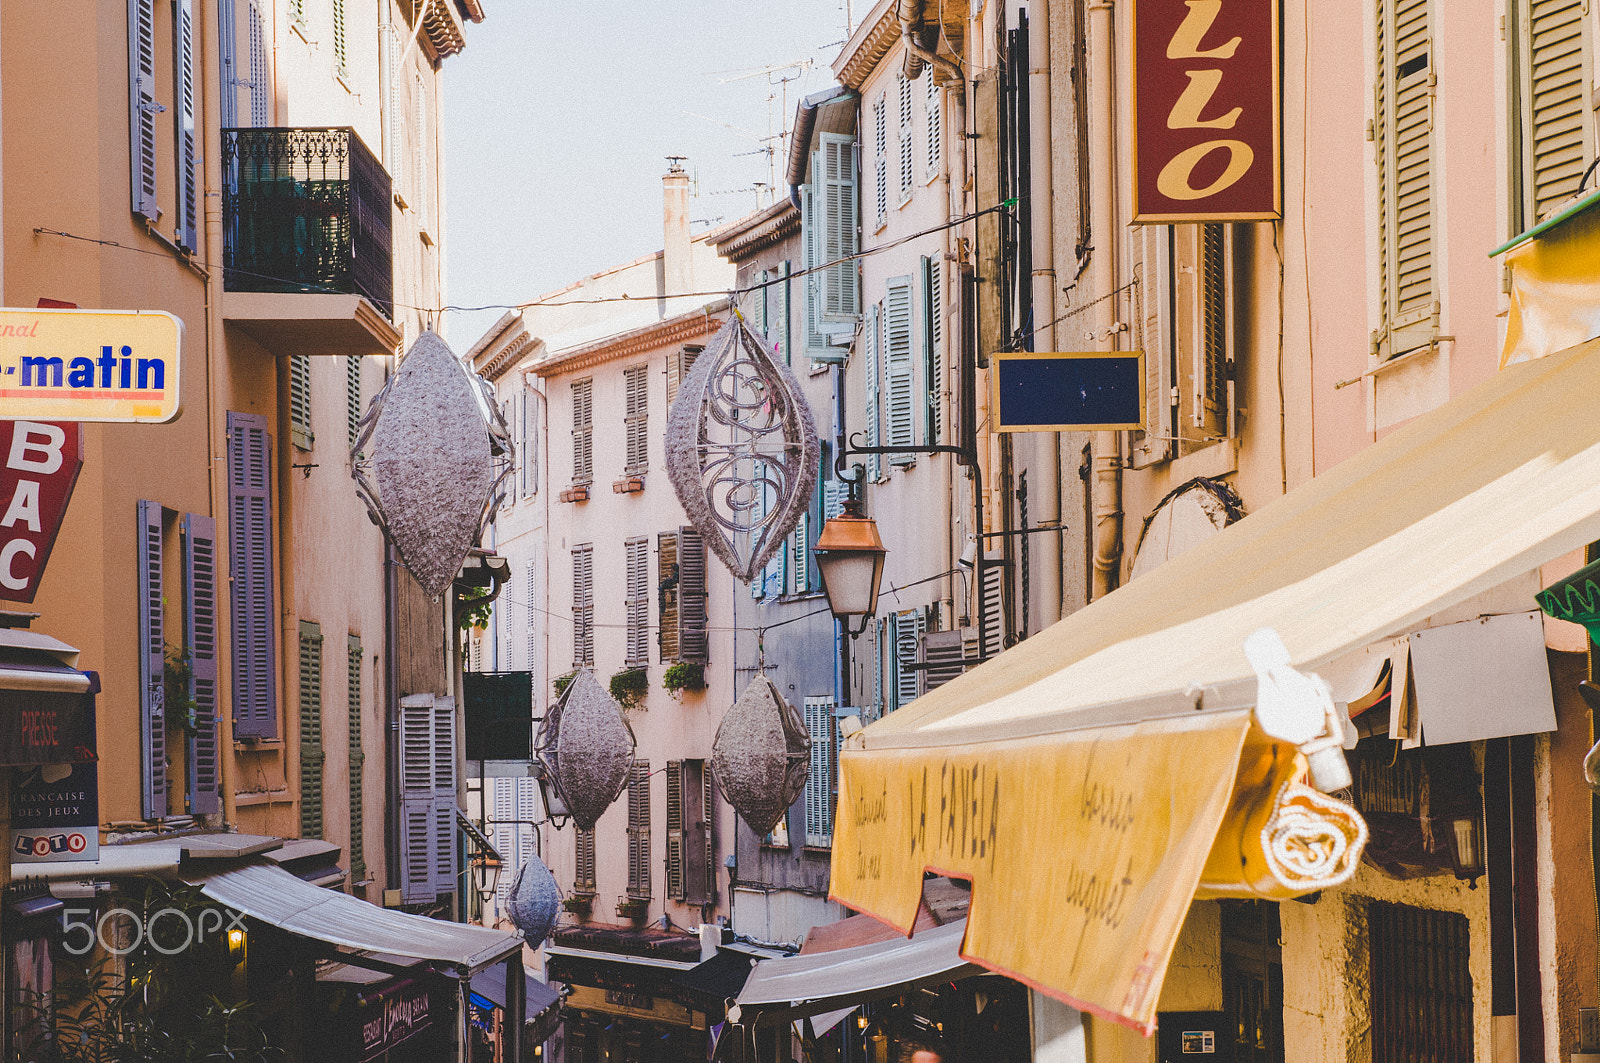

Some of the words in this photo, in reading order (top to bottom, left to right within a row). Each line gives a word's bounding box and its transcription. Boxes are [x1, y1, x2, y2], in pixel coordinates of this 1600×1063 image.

[0, 321, 39, 338] nal
[0, 345, 165, 390] -matin
[22, 711, 59, 746] PRESSE
[18, 808, 42, 817] DES
[49, 806, 80, 817] JEUX
[910, 765, 927, 860] LA
[939, 759, 999, 880] FAVELA
[15, 833, 87, 857] LOTO
